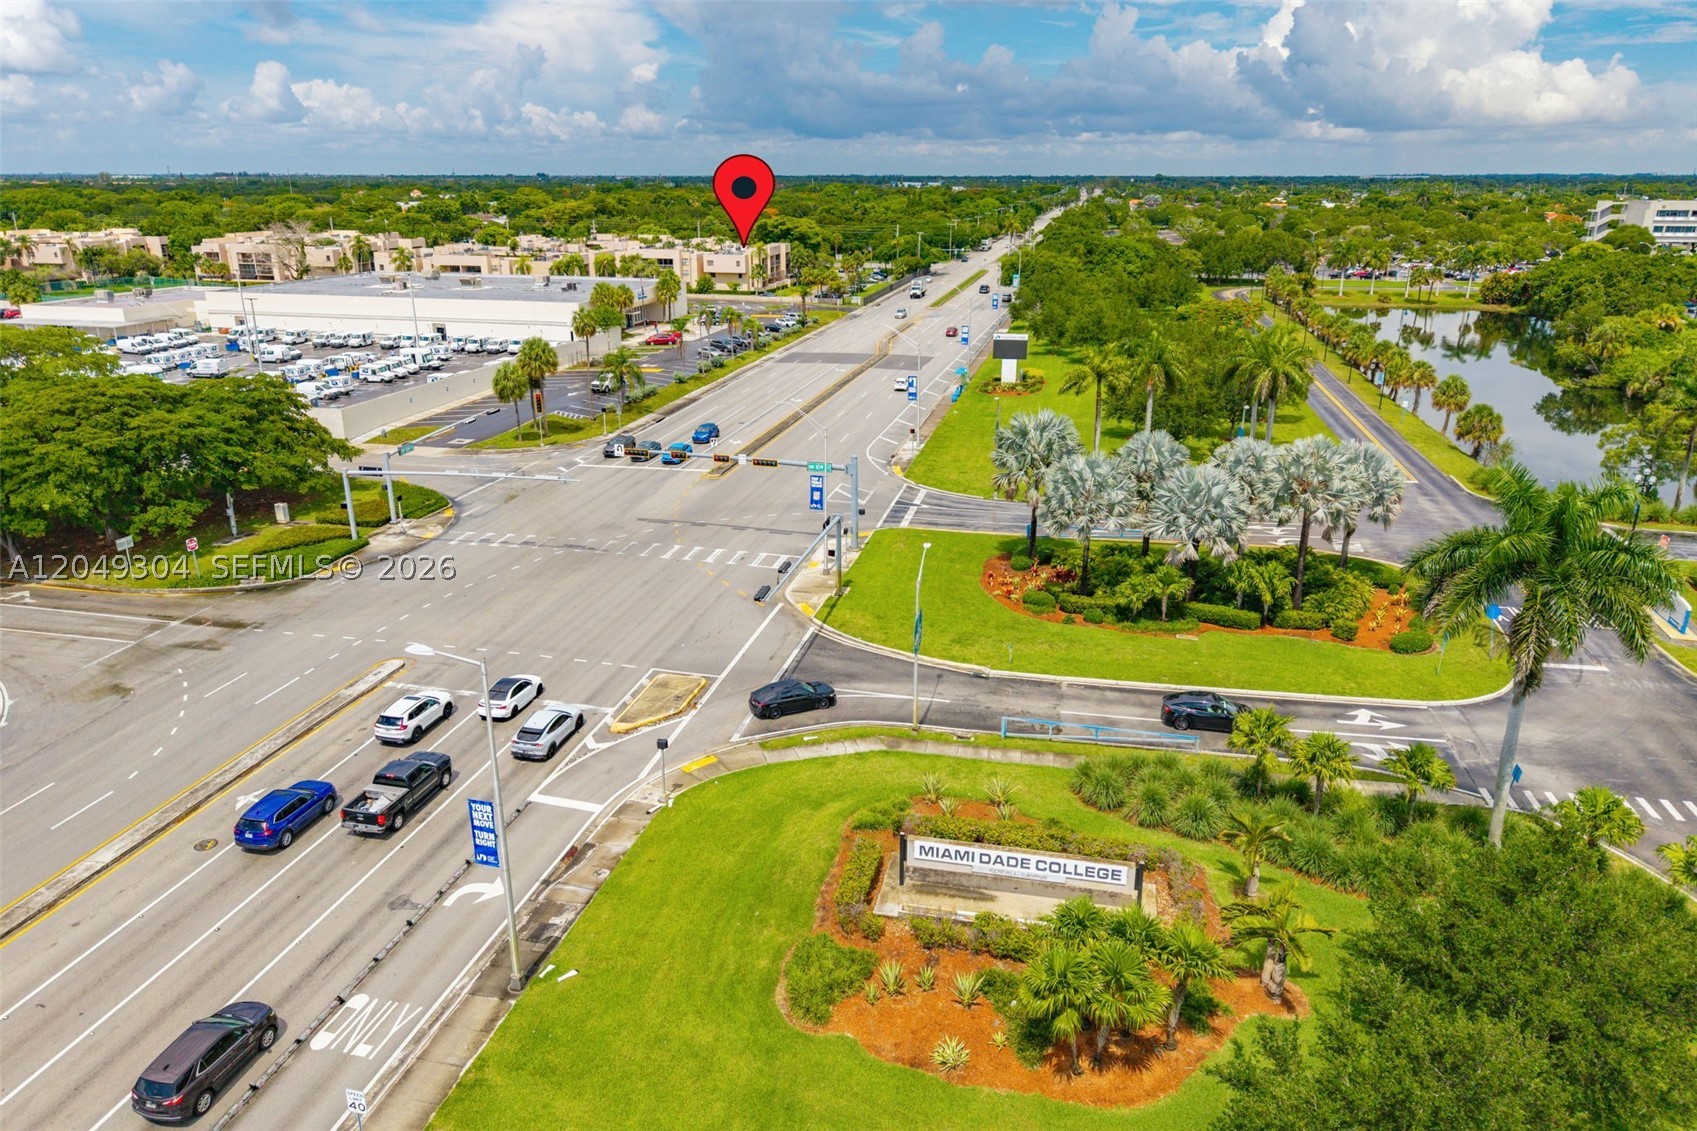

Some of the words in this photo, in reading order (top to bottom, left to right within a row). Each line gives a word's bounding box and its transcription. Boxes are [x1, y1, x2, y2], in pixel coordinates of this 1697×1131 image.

[470, 802, 492, 813] YOUR
[472, 810, 493, 821] NEXT
[473, 819, 494, 829] MOVE
[474, 829, 495, 841] TURN
[475, 838, 496, 848] RIGHT
[919, 845, 975, 863] MIAMI
[979, 852, 1031, 870] DADE
[1035, 859, 1122, 881] COLLEGE
[989, 867, 1017, 876] KENDALL
[1021, 872, 1048, 880] CAMPUS
[309, 993, 423, 1060] ONLY
[347, 1090, 363, 1098] SPEED
[349, 1101, 366, 1112] 40
